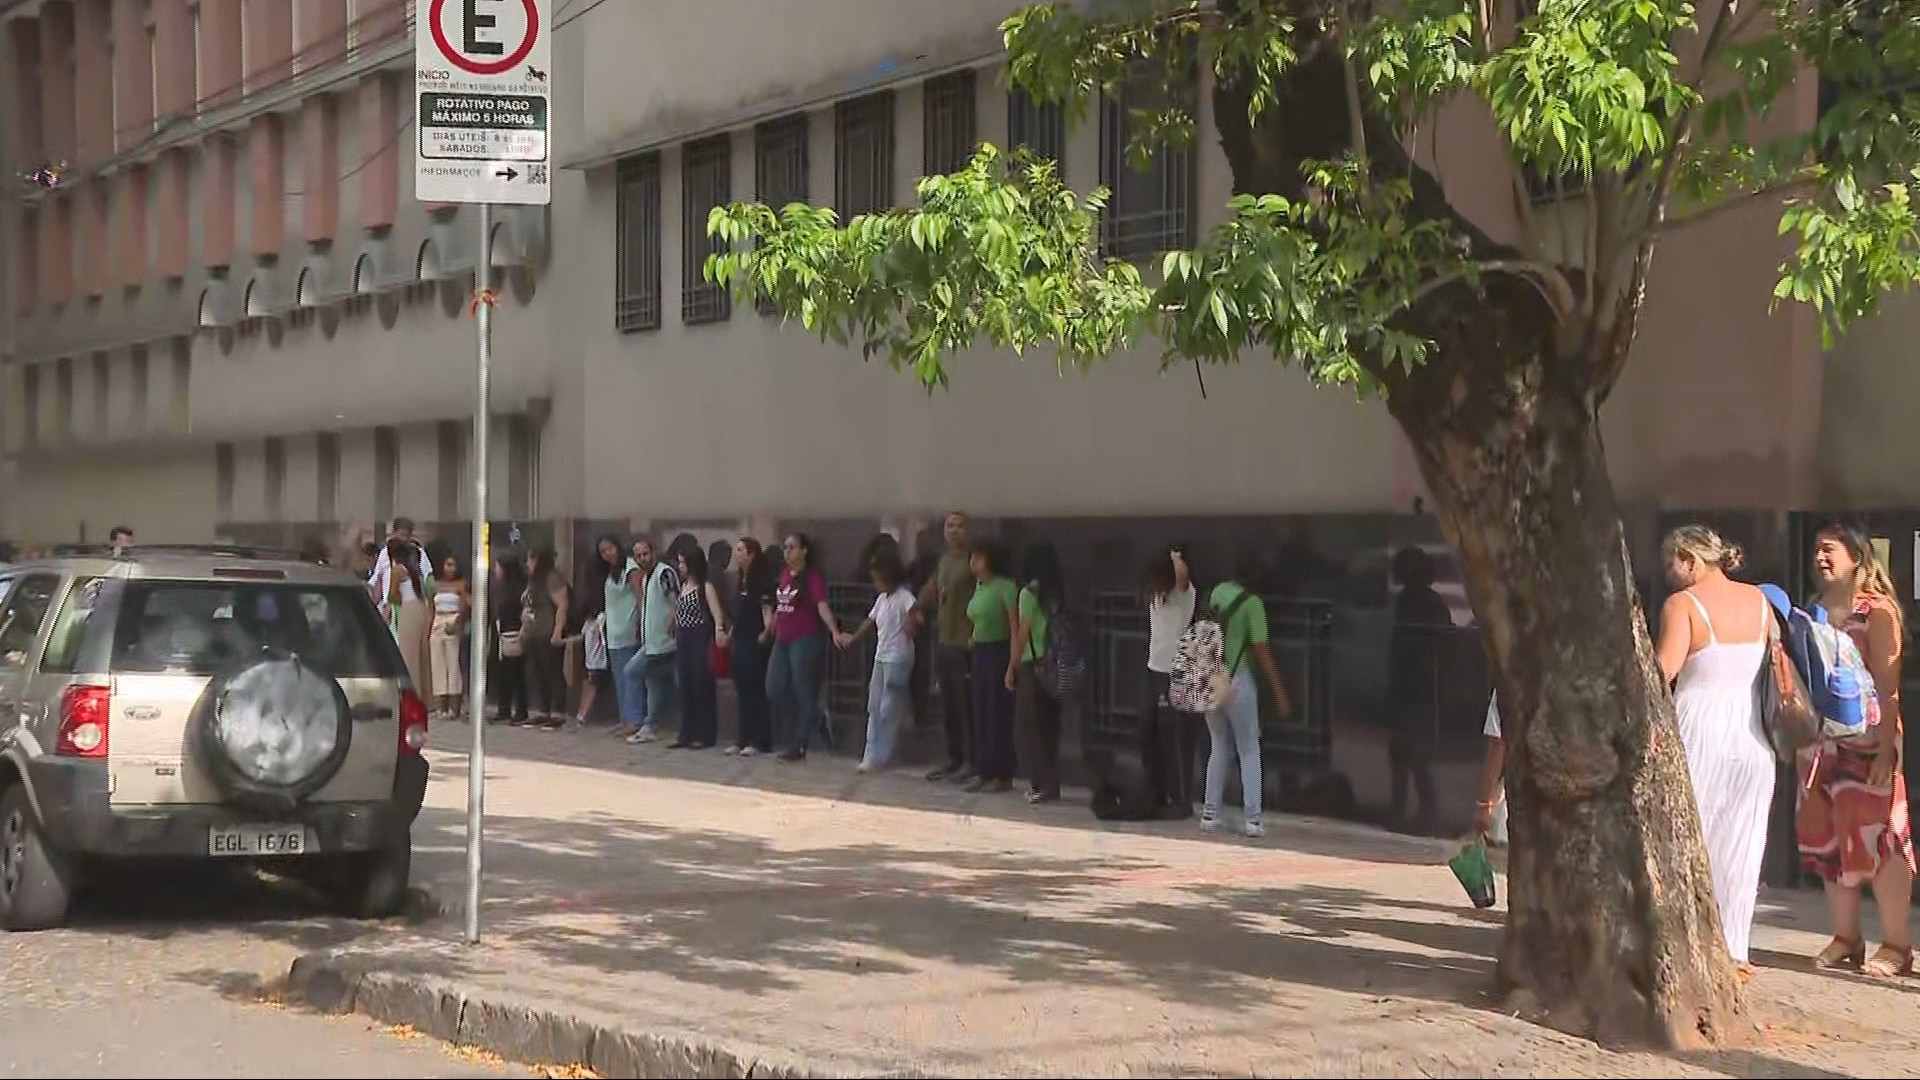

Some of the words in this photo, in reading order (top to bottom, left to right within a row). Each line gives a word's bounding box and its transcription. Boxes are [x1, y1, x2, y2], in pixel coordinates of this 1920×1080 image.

[463, 0, 503, 54] E
[497, 100, 530, 111] PAGO
[484, 112, 491, 122] 5
[493, 113, 534, 125] HORAS
[433, 132, 456, 142] DIAS
[215, 834, 247, 852] EGL
[257, 833, 299, 851] 1676
